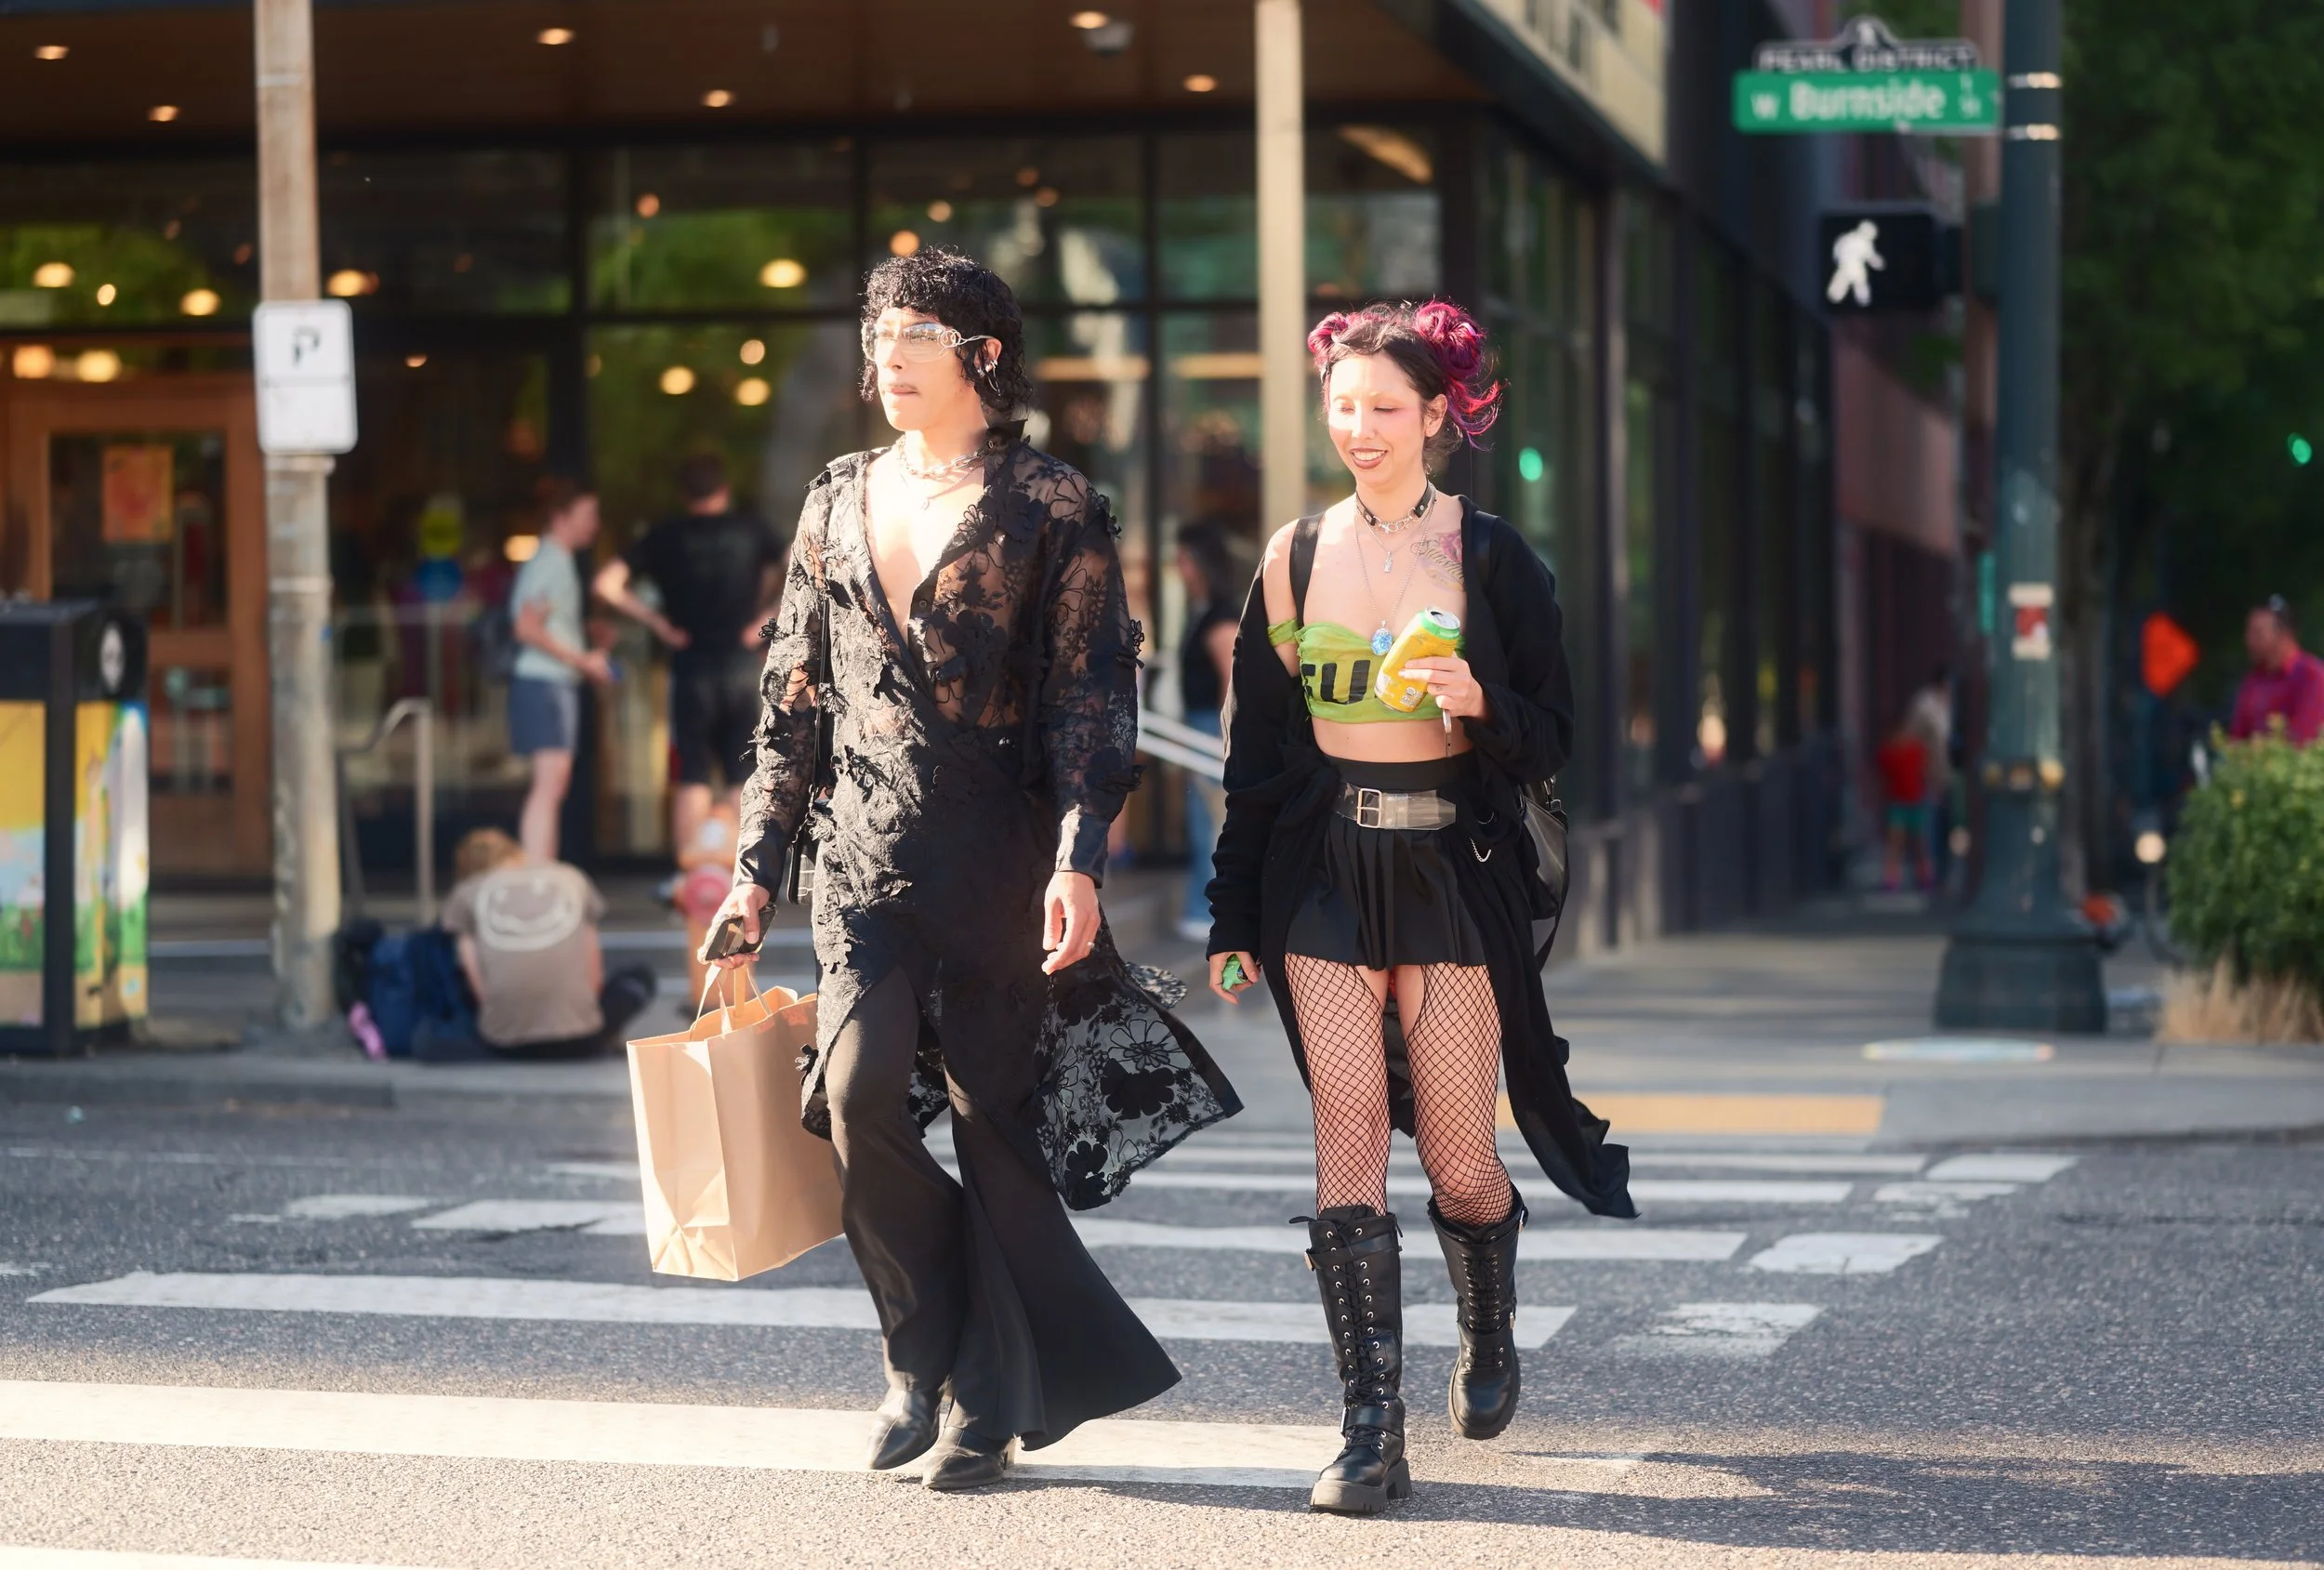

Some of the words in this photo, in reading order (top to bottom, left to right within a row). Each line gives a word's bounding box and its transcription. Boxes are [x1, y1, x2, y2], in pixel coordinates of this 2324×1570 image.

[1852, 48, 1974, 72] DISTRICT
[1789, 81, 1946, 121] Burnside
[291, 326, 322, 368] P
